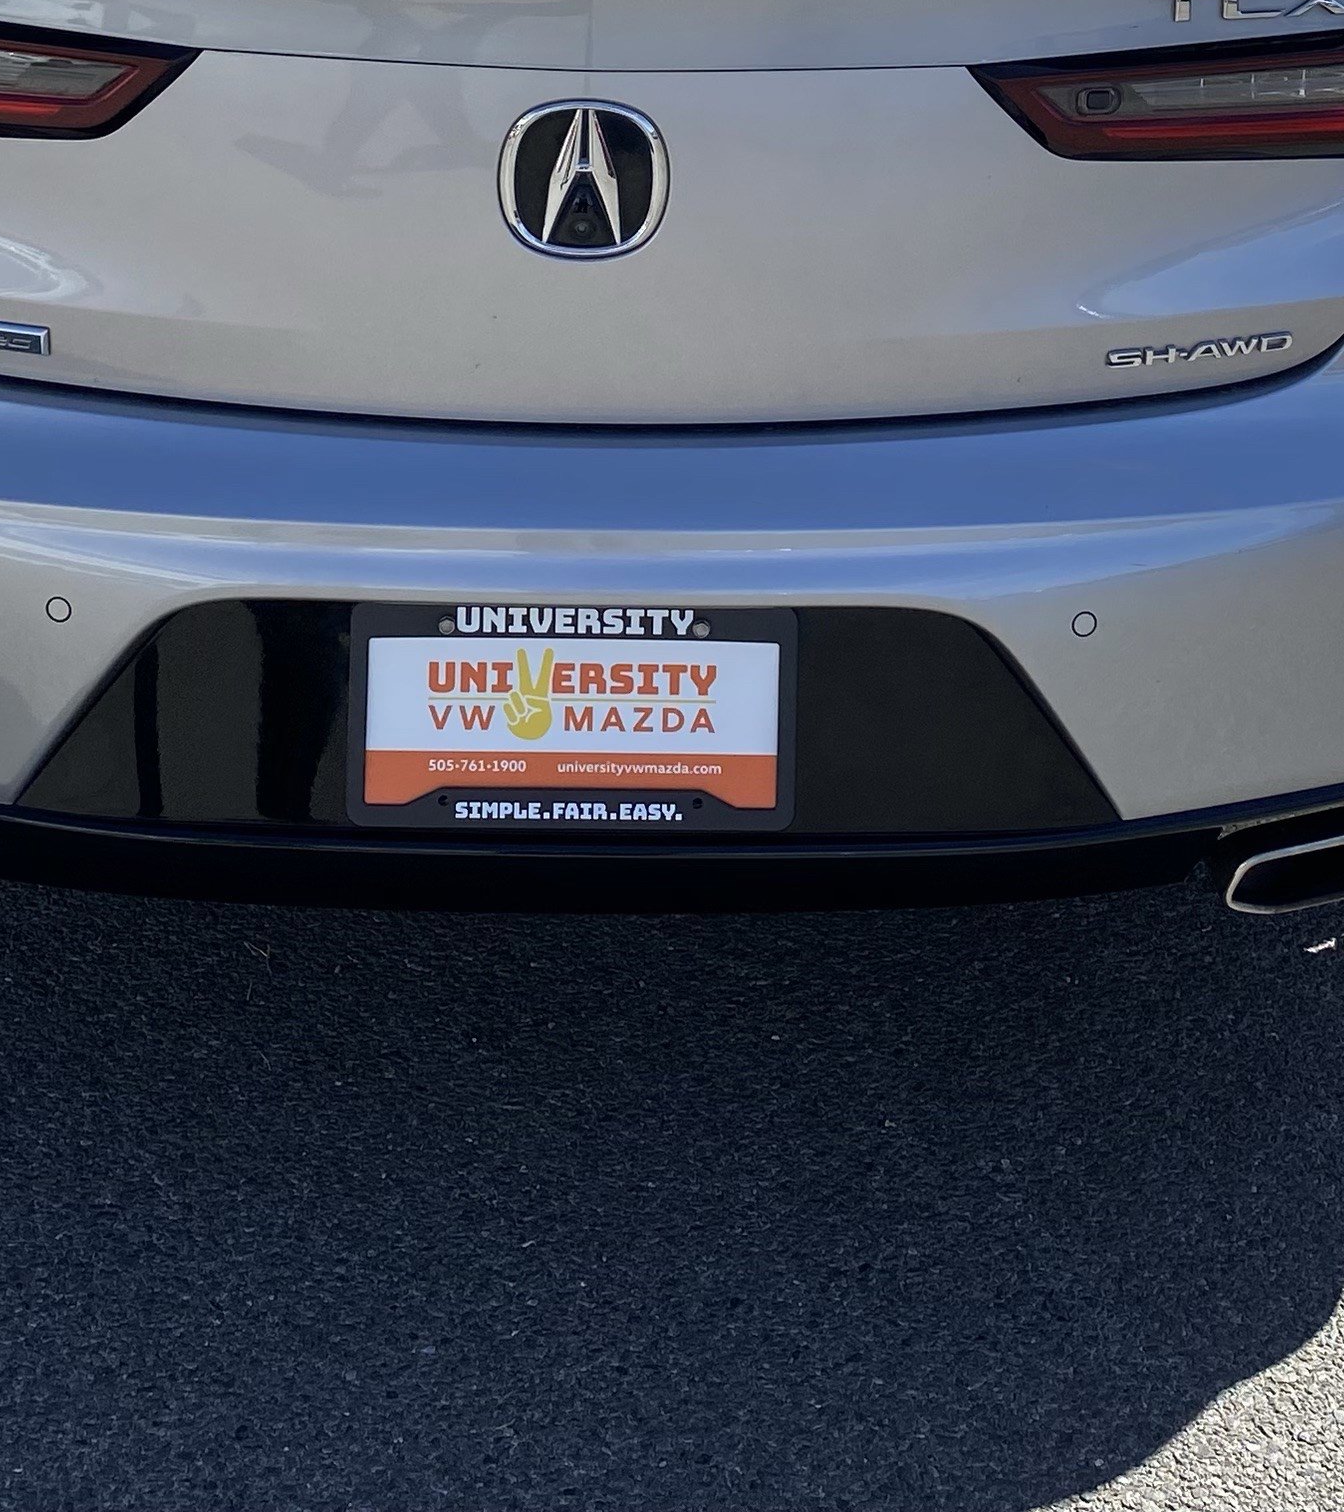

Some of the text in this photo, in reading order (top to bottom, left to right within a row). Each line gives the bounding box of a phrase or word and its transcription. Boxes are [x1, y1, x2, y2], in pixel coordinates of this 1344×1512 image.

[1106, 332, 1294, 369] SH-AWD
[456, 606, 694, 637] UNIVERSITY
[428, 704, 716, 734] VW MAZDA
[557, 760, 722, 777] universityvwmazda.com
